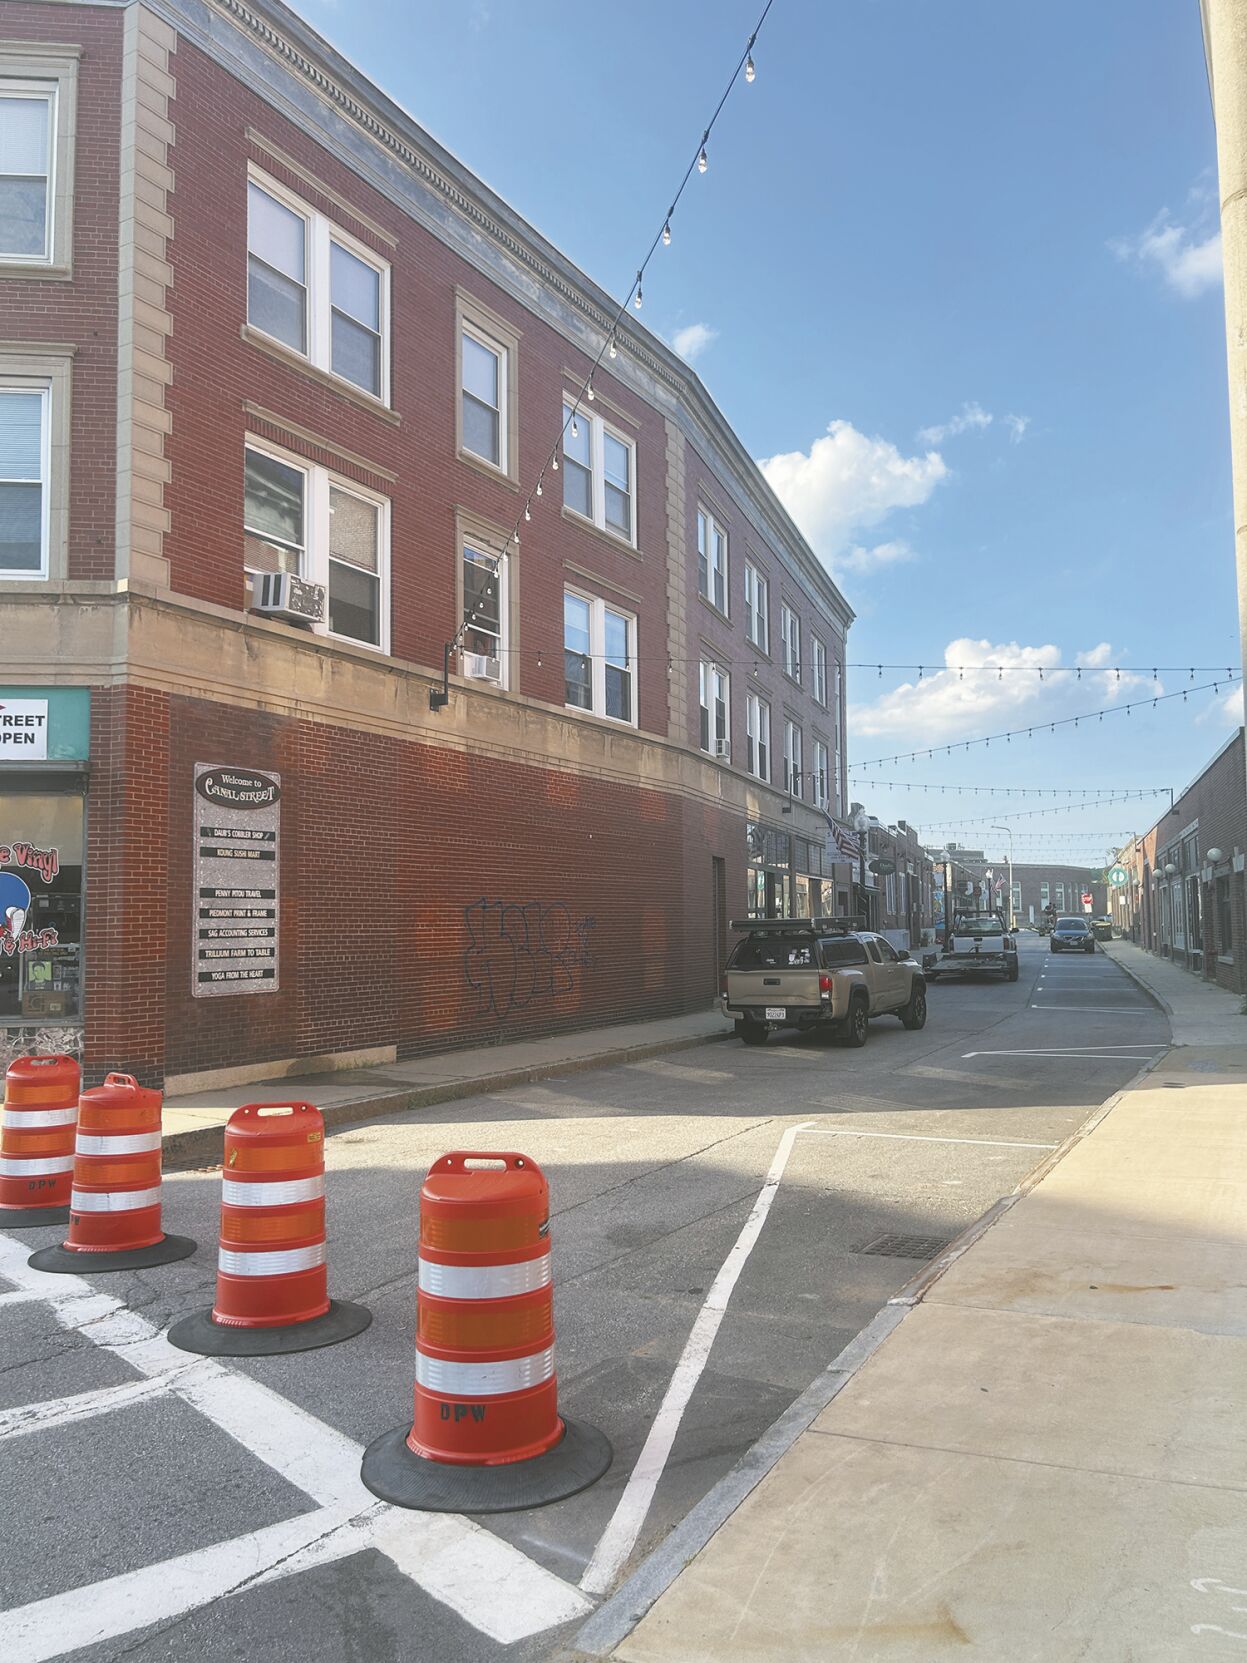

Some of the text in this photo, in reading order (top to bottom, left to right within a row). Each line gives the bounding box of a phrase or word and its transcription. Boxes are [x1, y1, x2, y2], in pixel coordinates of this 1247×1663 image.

[0, 715, 45, 726] REET
[0, 732, 35, 744] PEN
[221, 774, 262, 788] Welcome to
[240, 786, 275, 803] STREET
[232, 830, 251, 838] COBBLER
[252, 832, 264, 840] SHOP
[248, 850, 260, 858] MART
[13, 843, 59, 883] Vinyl
[246, 890, 262, 898] TRAVEL
[209, 909, 232, 917] PIEDMONT
[218, 929, 248, 937] ACCOUNTING
[248, 928, 268, 936] SERVICES
[205, 950, 230, 958] TRILLIUM
[230, 949, 246, 957] FARM
[256, 948, 270, 956] TABLE
[211, 972, 225, 980] YOGA
[226, 971, 239, 979] FROM
[249, 970, 263, 978] HEART
[440, 1404, 485, 1422] DPW
